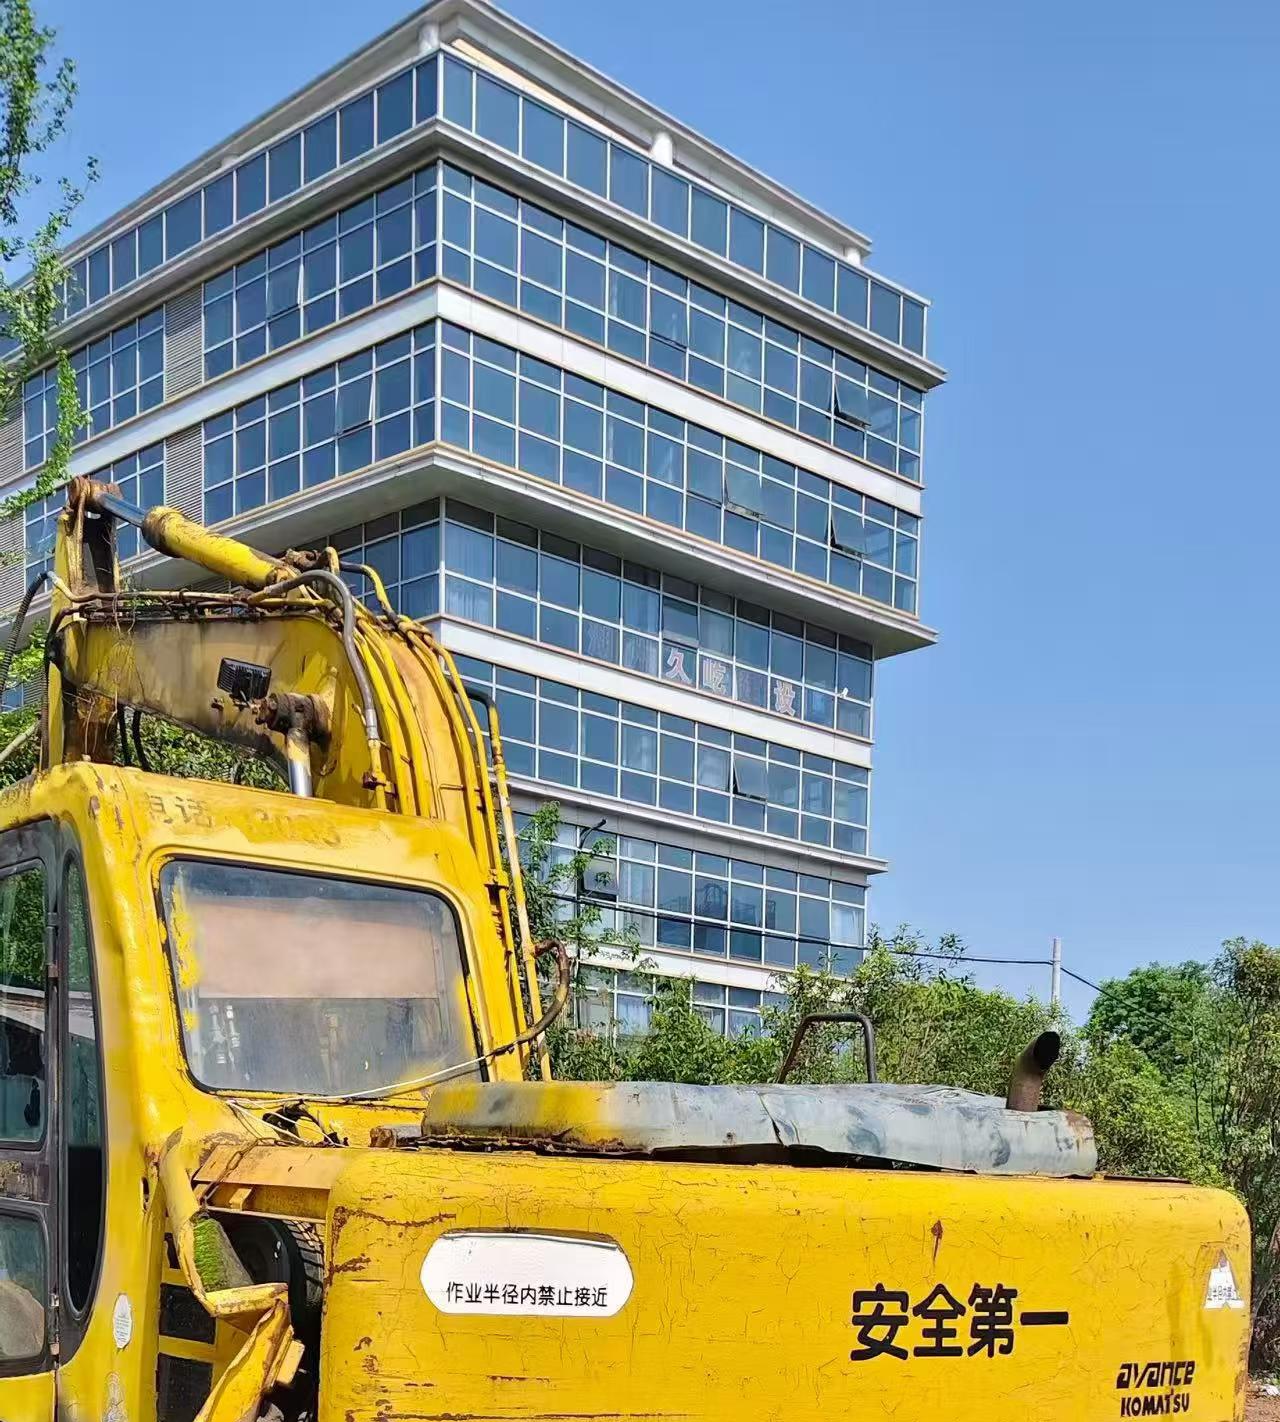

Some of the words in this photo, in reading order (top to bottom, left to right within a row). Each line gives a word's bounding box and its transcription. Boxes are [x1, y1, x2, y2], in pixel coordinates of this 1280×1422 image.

[446, 1281, 608, 1307] 作业半径内禁止接近
[850, 1283, 1069, 1361] 安全第一
[1116, 1360, 1196, 1389] avance
[1120, 1393, 1190, 1417] KOMATSU
